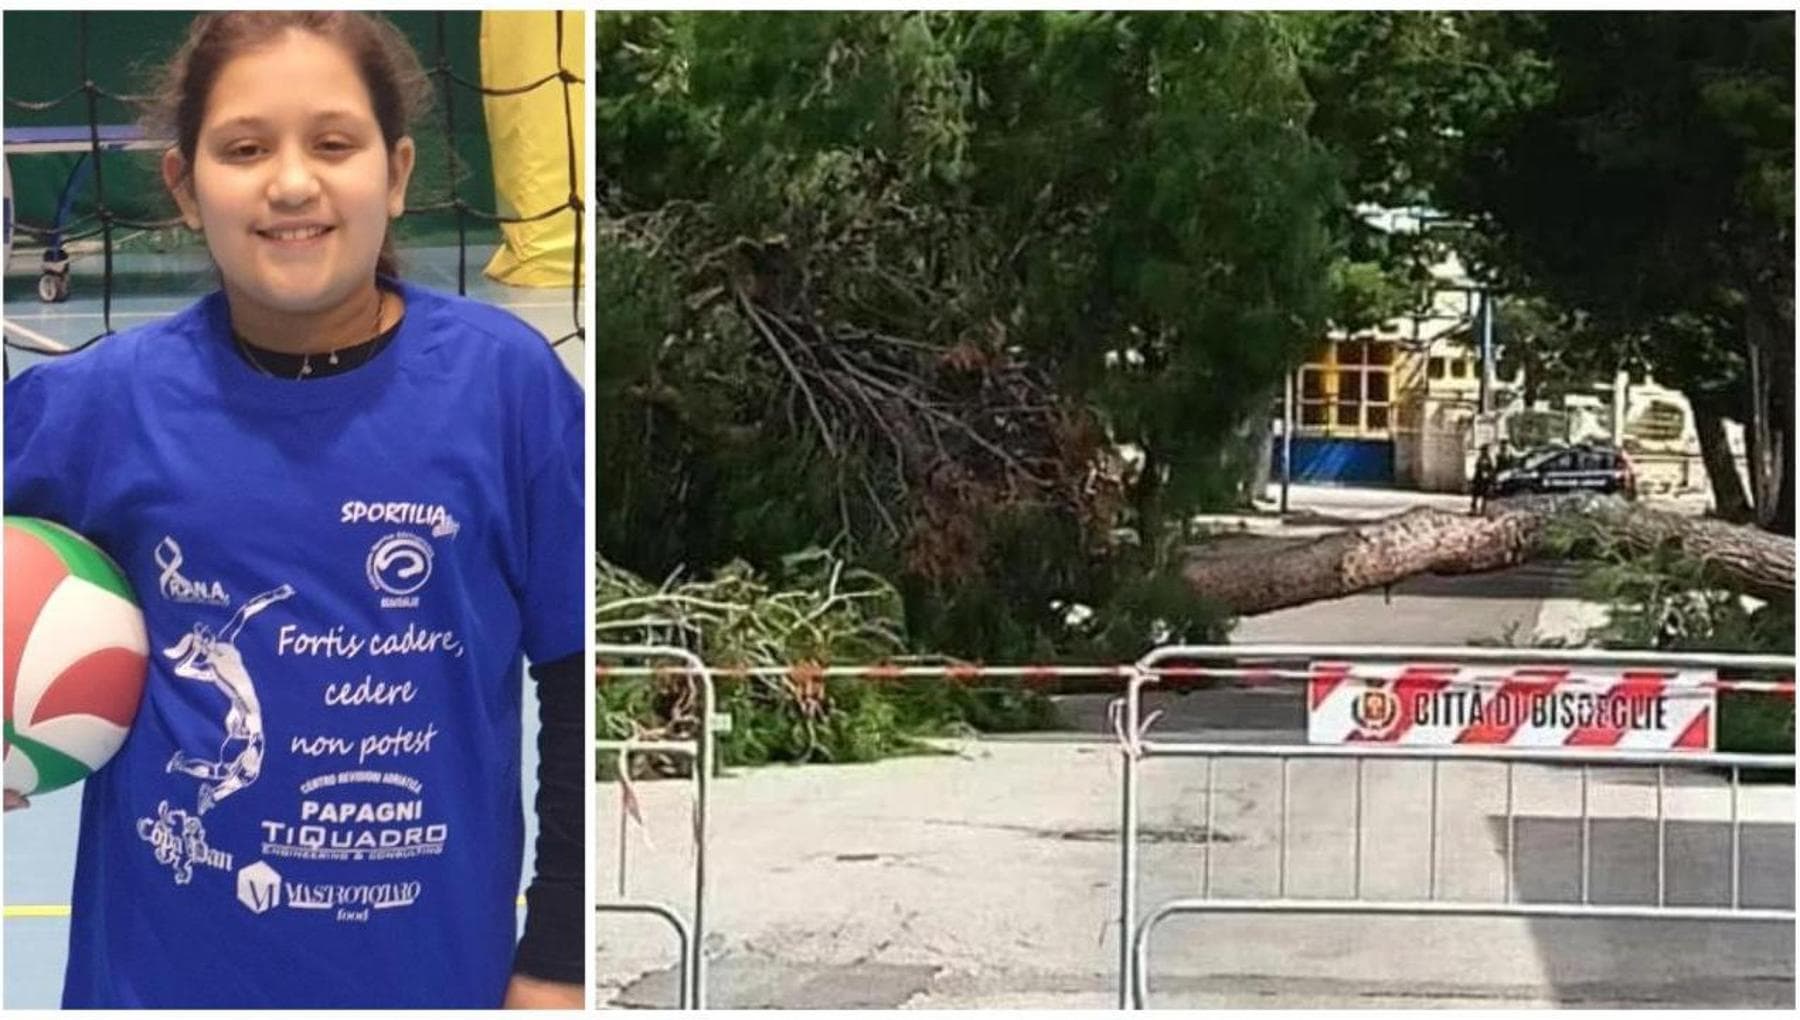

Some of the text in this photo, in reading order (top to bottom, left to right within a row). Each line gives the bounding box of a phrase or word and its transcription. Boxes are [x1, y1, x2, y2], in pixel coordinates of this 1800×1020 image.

[340, 500, 446, 526] SPORTILIA
[278, 622, 464, 659] Fortis cadere,
[324, 674, 418, 706] cedere
[1496, 691, 1520, 727] DI
[291, 722, 438, 765] non potest
[301, 800, 423, 823] PAPAGNI
[336, 908, 369, 922] food
